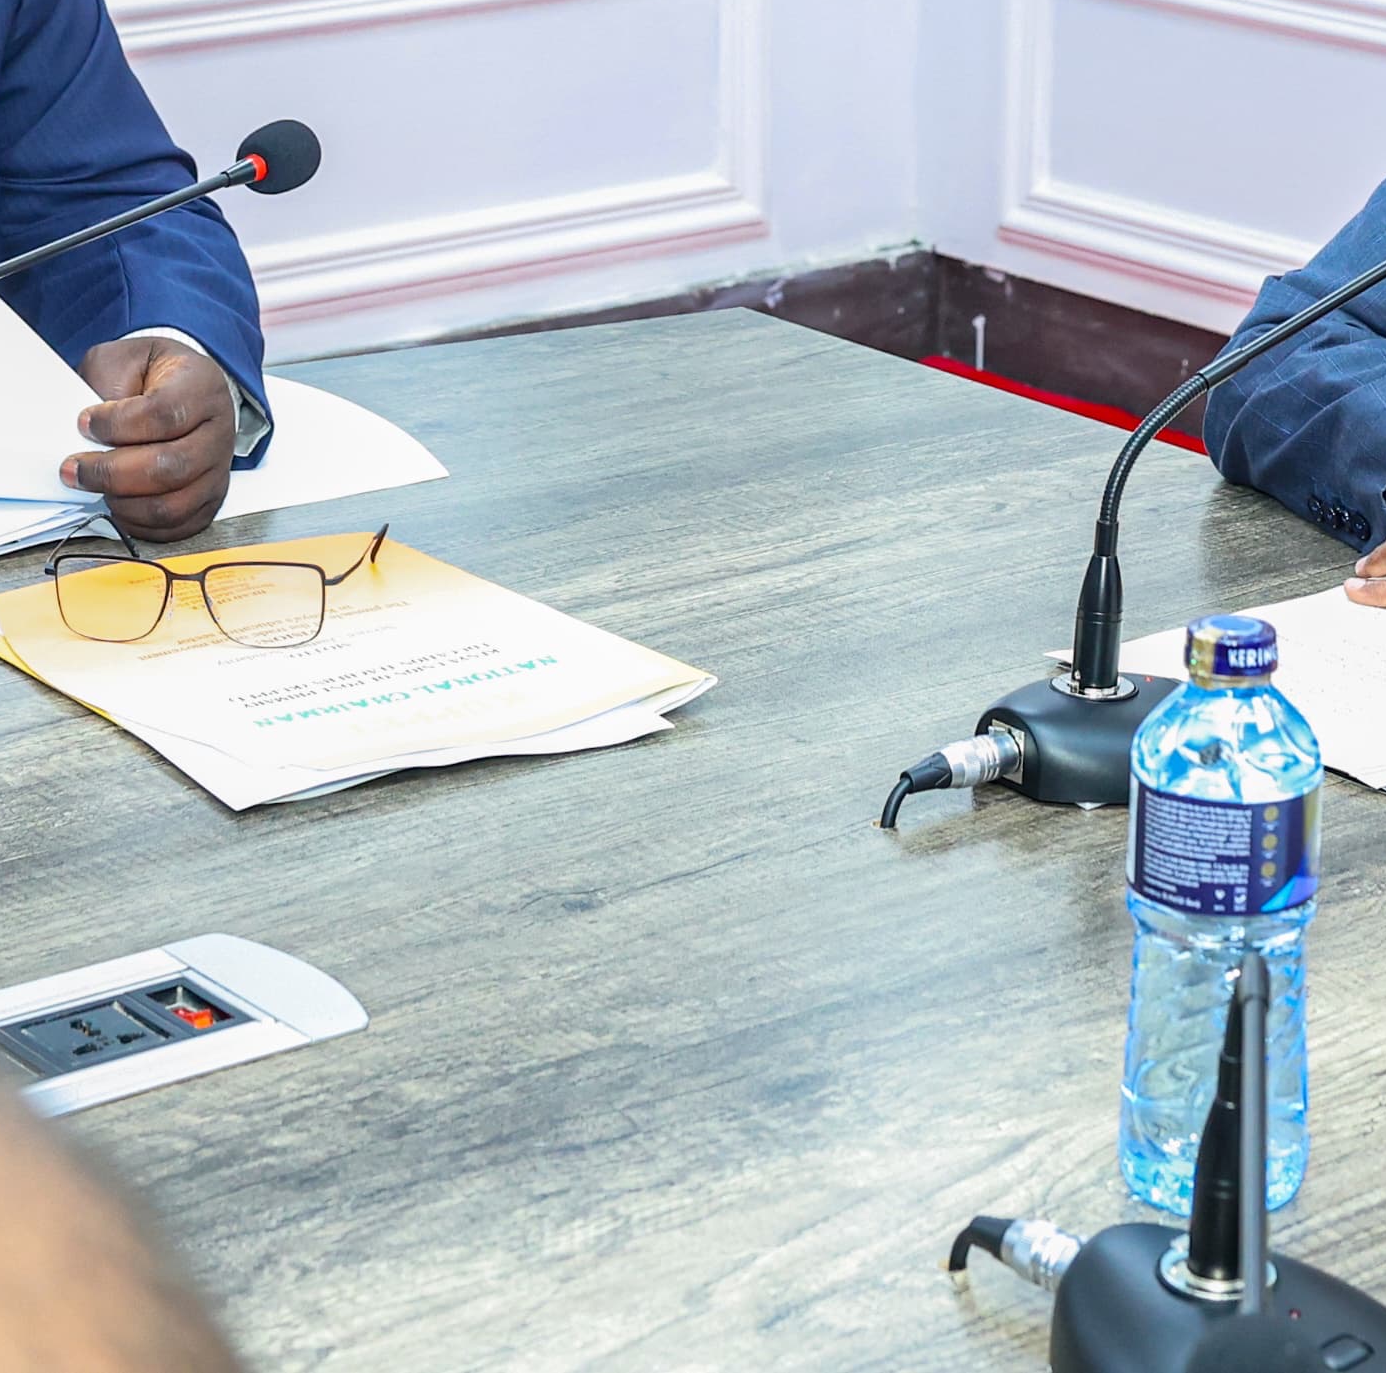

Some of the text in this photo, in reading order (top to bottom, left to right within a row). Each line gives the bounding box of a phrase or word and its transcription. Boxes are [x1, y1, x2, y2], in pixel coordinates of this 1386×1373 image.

[244, 690, 317, 708] PRIMARY
[253, 656, 558, 727] NATIONAL CHAIRMAN
